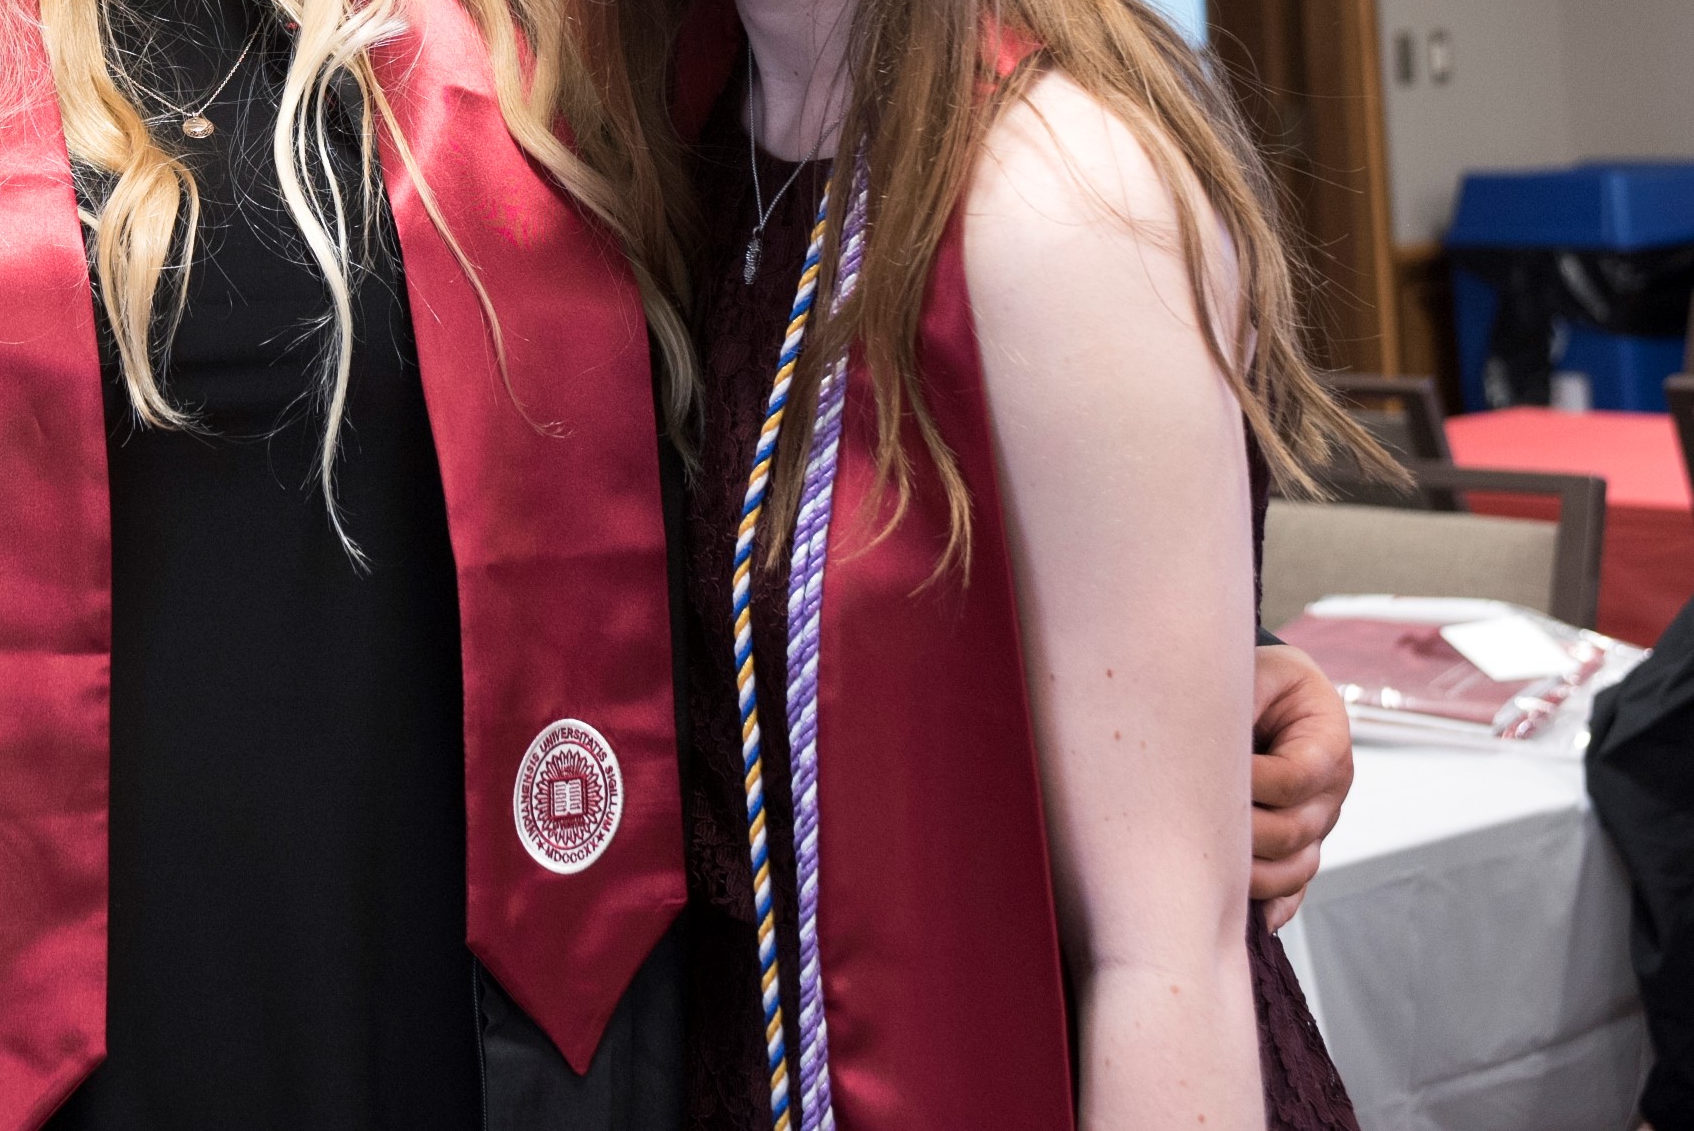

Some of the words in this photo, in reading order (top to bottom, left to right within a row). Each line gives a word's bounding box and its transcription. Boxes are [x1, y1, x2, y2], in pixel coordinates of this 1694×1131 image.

[539, 727, 608, 762] UNIVERSITATIS
[601, 765, 618, 833] SIGILLUM
[545, 838, 599, 864] MDCCCXX
